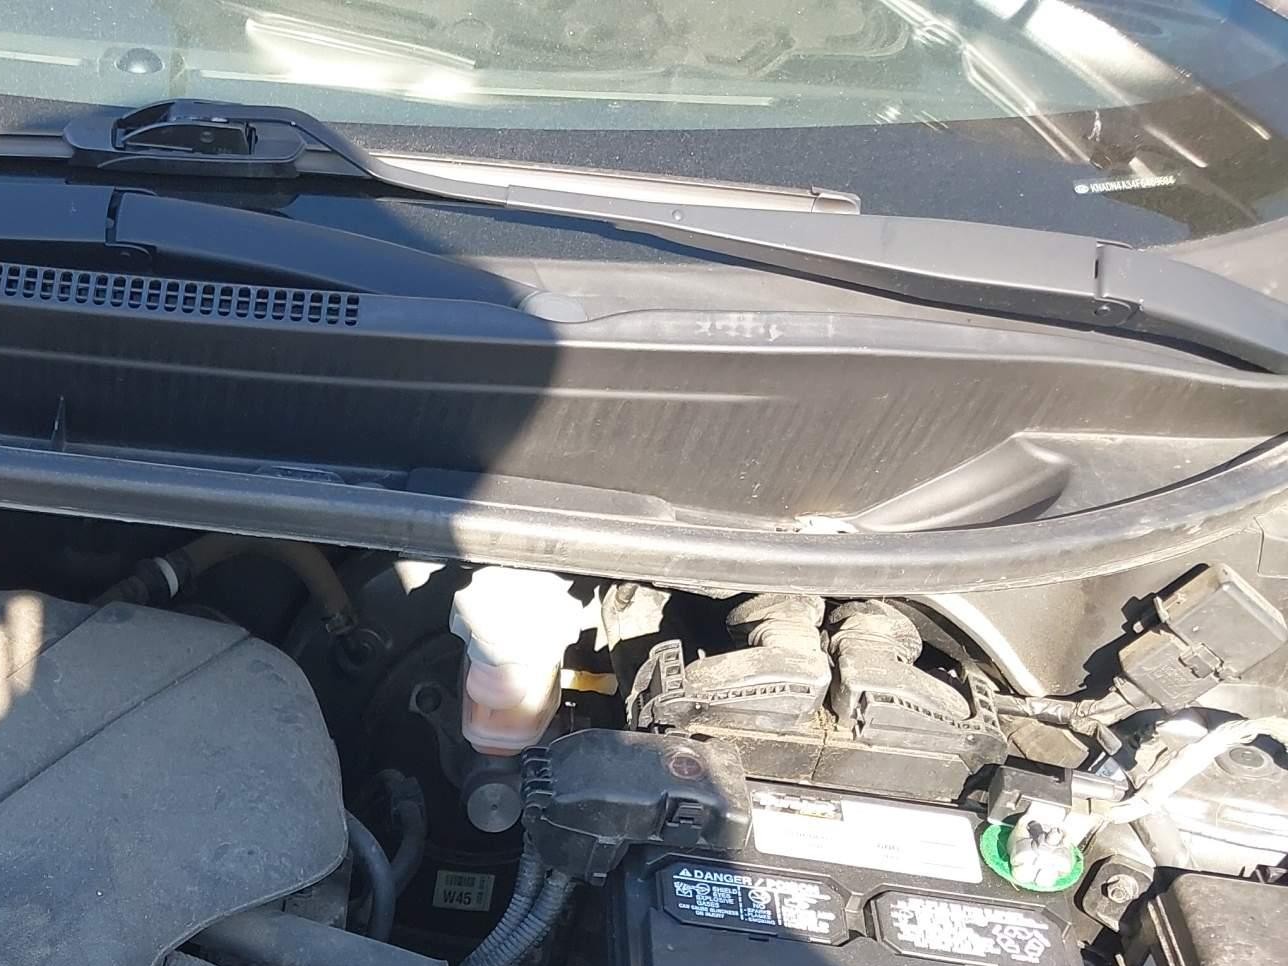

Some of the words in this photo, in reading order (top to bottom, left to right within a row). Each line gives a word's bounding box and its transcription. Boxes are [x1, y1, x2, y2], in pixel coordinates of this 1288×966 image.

[694, 869, 753, 886] DANGER
[443, 889, 472, 905] W45
[712, 886, 738, 895] SHIELD
